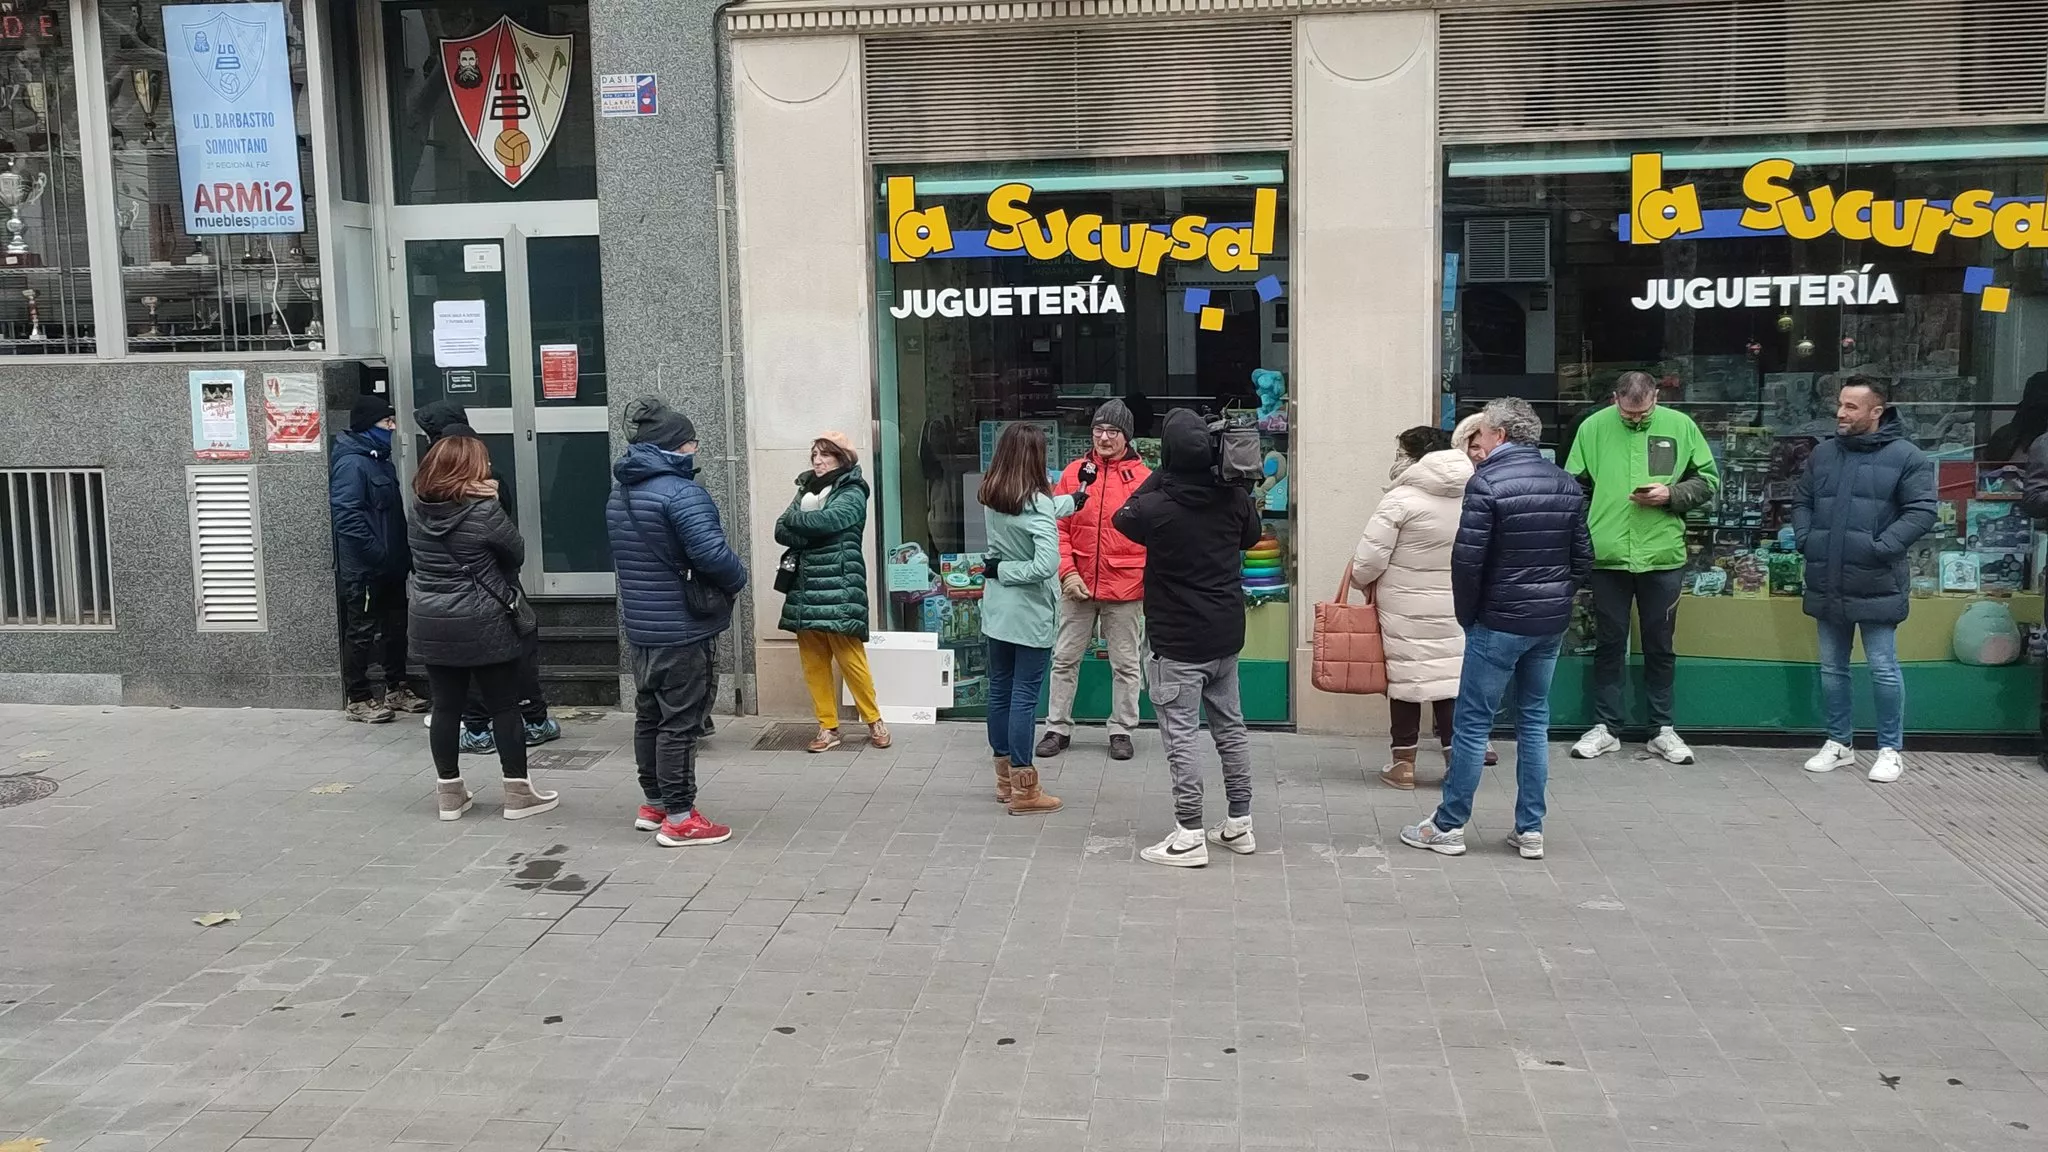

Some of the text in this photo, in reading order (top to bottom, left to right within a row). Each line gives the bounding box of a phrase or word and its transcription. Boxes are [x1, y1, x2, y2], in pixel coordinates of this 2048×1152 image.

[602, 75, 635, 84] DASIT
[193, 112, 275, 129] U.D. BARBASTRO
[205, 138, 268, 154] SOMONTANO
[1631, 152, 2048, 254] la Sucursa
[195, 213, 295, 228] mueblespacios
[886, 175, 1278, 276] la Sucursal
[889, 275, 1125, 319] JUGUETERÍA
[1631, 263, 1899, 310] JUGUETERÍA
